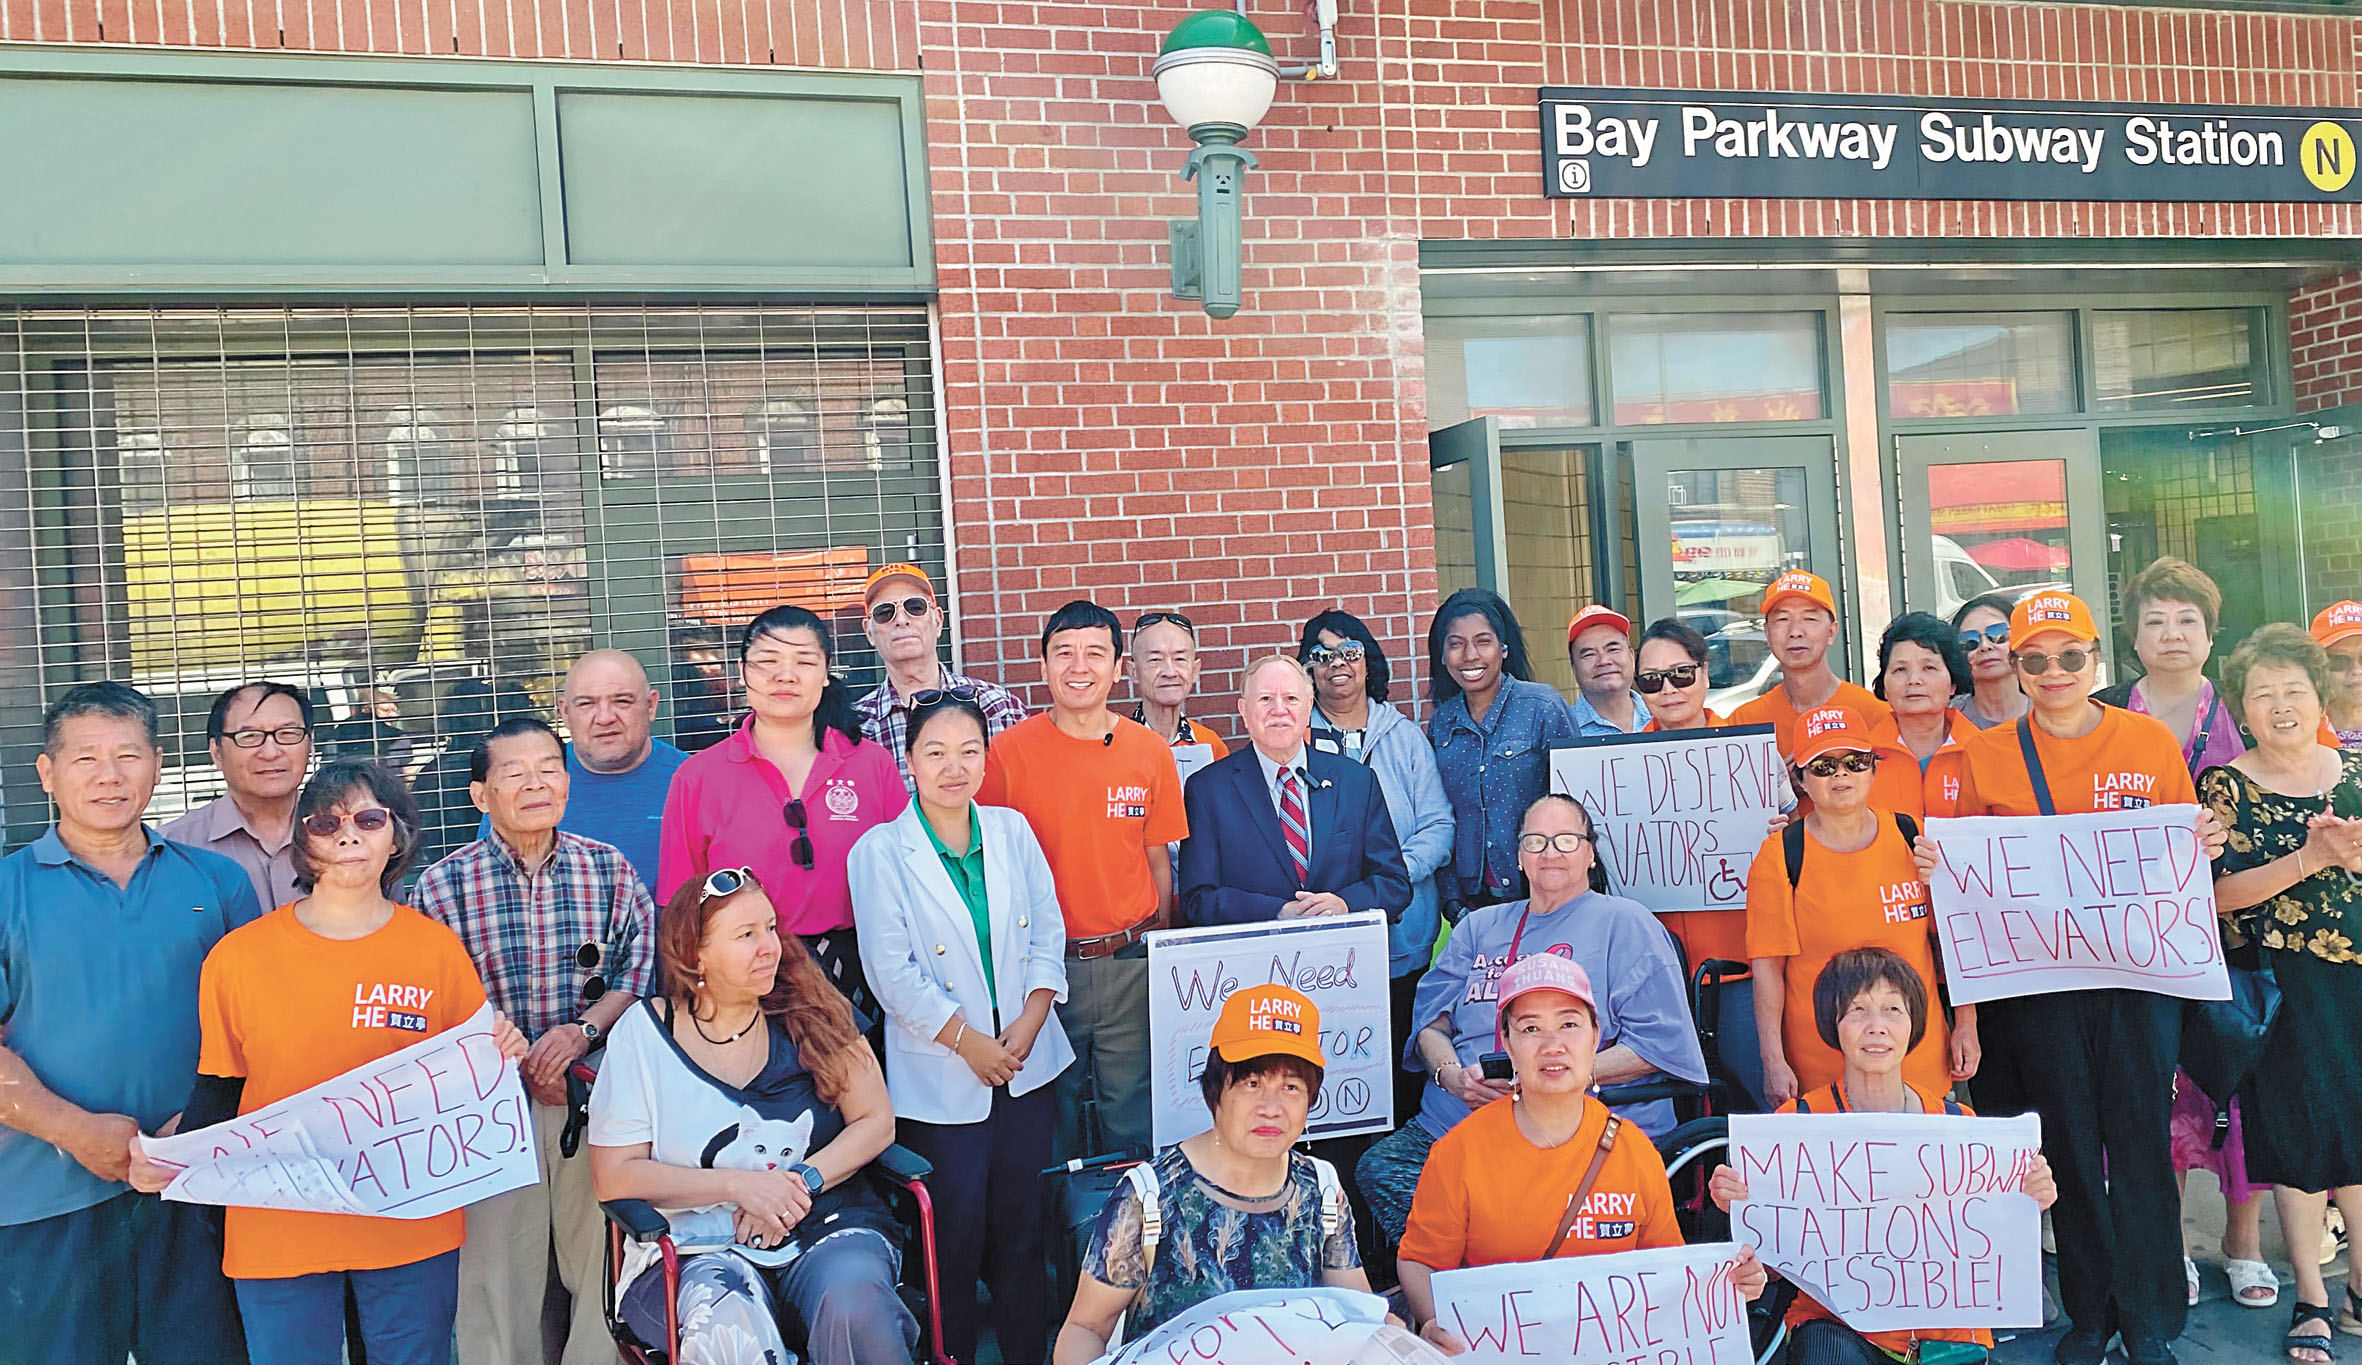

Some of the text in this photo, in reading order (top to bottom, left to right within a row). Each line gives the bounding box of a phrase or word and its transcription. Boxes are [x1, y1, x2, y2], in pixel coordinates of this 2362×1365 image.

[1555, 104, 2342, 176] Bay Parkway Subway Station N
[2027, 597, 2070, 614] LARRY
[2328, 605, 2362, 618] LARR
[2028, 610, 2045, 626] HE
[2329, 615, 2345, 627] HE
[1806, 710, 1844, 727] LARRY
[1808, 724, 1822, 738] HE
[1557, 741, 1776, 817] WE DESERVE
[2094, 772, 2155, 794] LARRY
[1107, 786, 1148, 802] LARRY
[2094, 793, 2119, 809] HE
[1107, 802, 1126, 818] HE
[1593, 820, 1718, 887] VATORS
[1937, 825, 2198, 898] WE NEED
[1883, 903, 1910, 924] HE
[1947, 897, 2223, 973] ELEVATORS!
[1172, 948, 1358, 1010] We Need
[354, 983, 434, 1010] LARRY
[352, 1006, 385, 1029] HE
[1250, 998, 1302, 1019] LARRY
[1250, 1015, 1271, 1031] HE
[322, 1033, 505, 1146] NEED
[1740, 1141, 1897, 1205] MAKE
[1566, 1216, 1595, 1240] HE
[1741, 1197, 1991, 1259] STATIONS
[1452, 1290, 1542, 1356] WE
[1573, 1272, 1664, 1356] ARE
